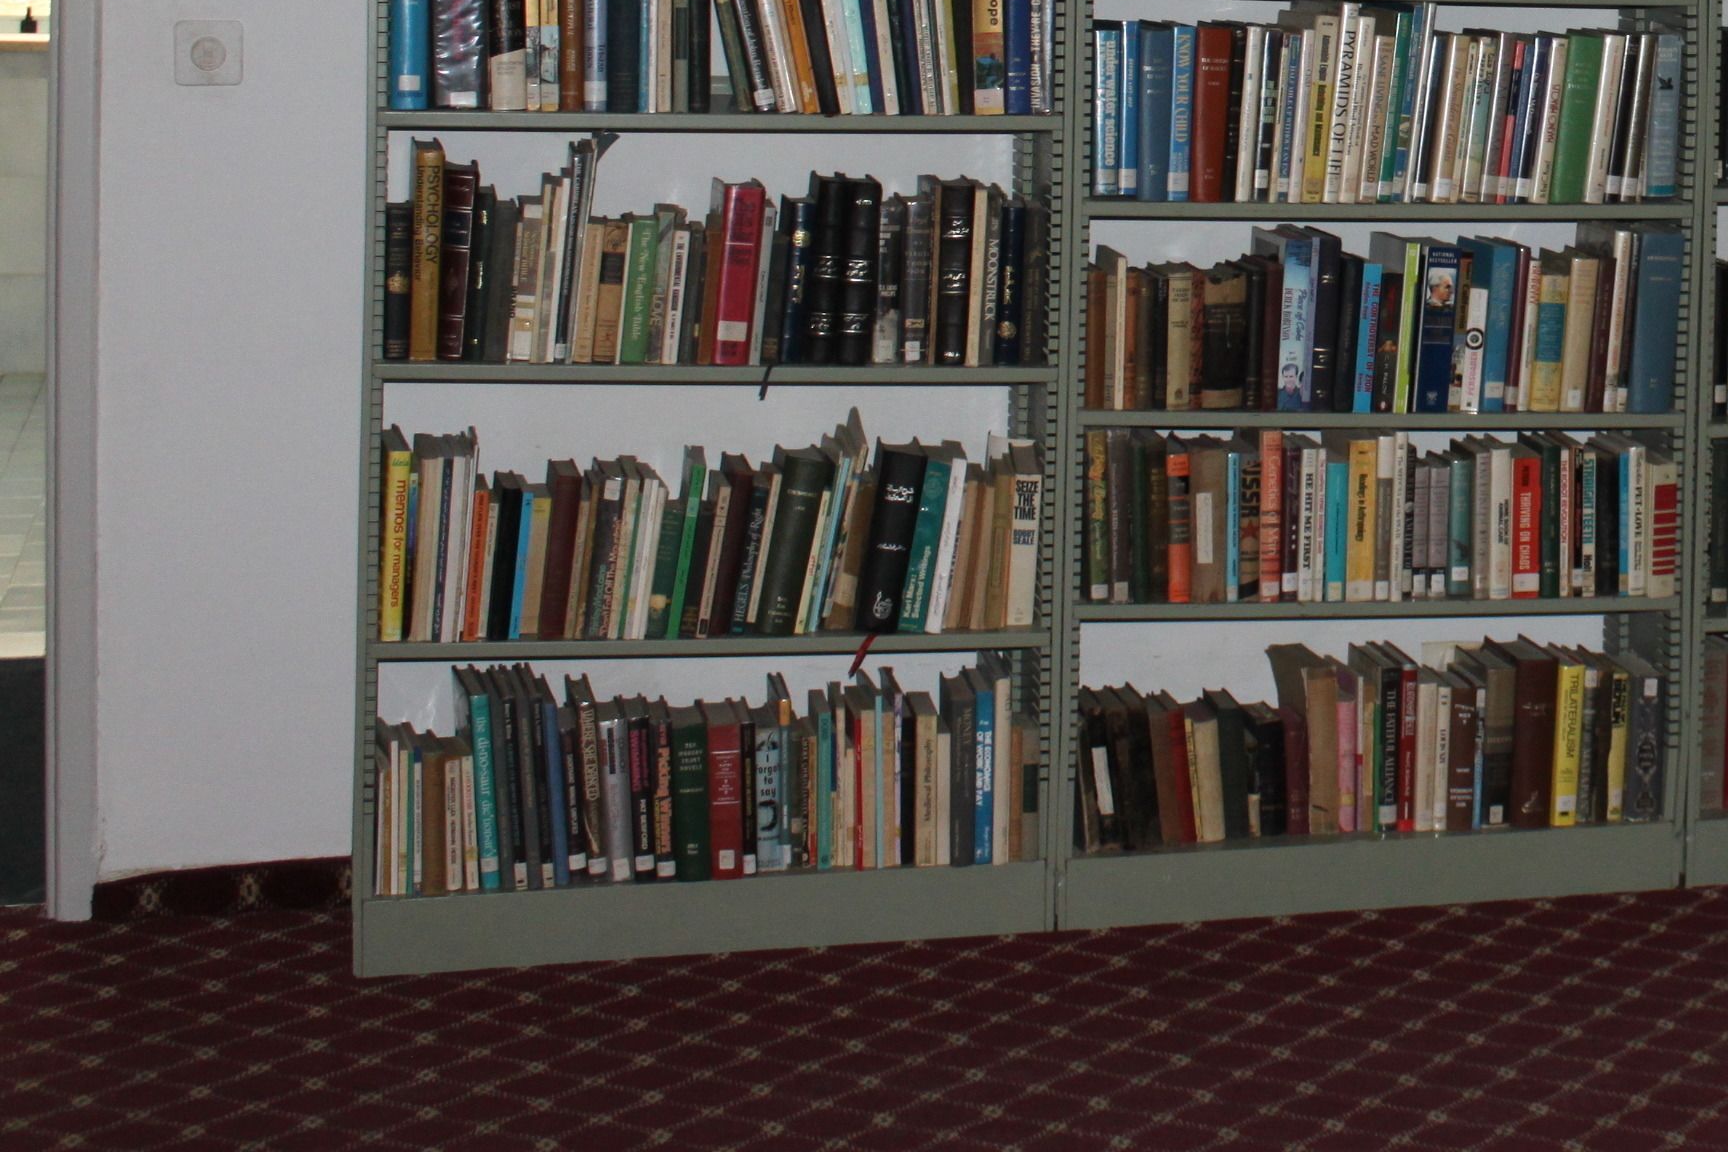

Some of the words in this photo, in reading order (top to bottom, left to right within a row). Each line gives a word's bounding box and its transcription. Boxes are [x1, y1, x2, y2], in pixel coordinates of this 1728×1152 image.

[1176, 34, 1192, 68] KNOW
[1378, 54, 1388, 80] SANE
[1030, 64, 1041, 109] INVASION
[1175, 73, 1190, 105] YOUR
[1335, 31, 1357, 117] PYRAMIDS
[1375, 81, 1387, 112] LIVING
[1175, 108, 1190, 142] CHILD
[1332, 122, 1347, 144] OF
[1370, 125, 1381, 151] MAD
[1104, 119, 1117, 166] science
[1366, 151, 1377, 184] WORLD
[415, 165, 424, 236] Understanding
[425, 165, 441, 264] PSYCHOLOGY
[414, 239, 424, 281] Behavior
[983, 239, 1000, 321] MOONSTRUCK
[1372, 283, 1380, 297] THE
[1015, 480, 1039, 493] SEIZE
[1267, 456, 1281, 510] Genetics
[1305, 473, 1313, 490] HE
[1583, 458, 1594, 509] STRAIGHT
[394, 479, 408, 533] memos
[1014, 507, 1036, 520] TIME
[1017, 493, 1035, 507] THE
[1304, 493, 1313, 513] HIT
[1519, 492, 1532, 528] THRIVING
[1304, 516, 1313, 534] ME
[1519, 531, 1531, 542] ON
[393, 538, 404, 551] for
[1303, 536, 1312, 569] FIRST
[1519, 545, 1531, 570] CHAOS
[389, 554, 402, 608] managers
[1566, 674, 1580, 758] TRILATERALISM
[657, 747, 672, 797] Picking
[761, 788, 777, 798] say
